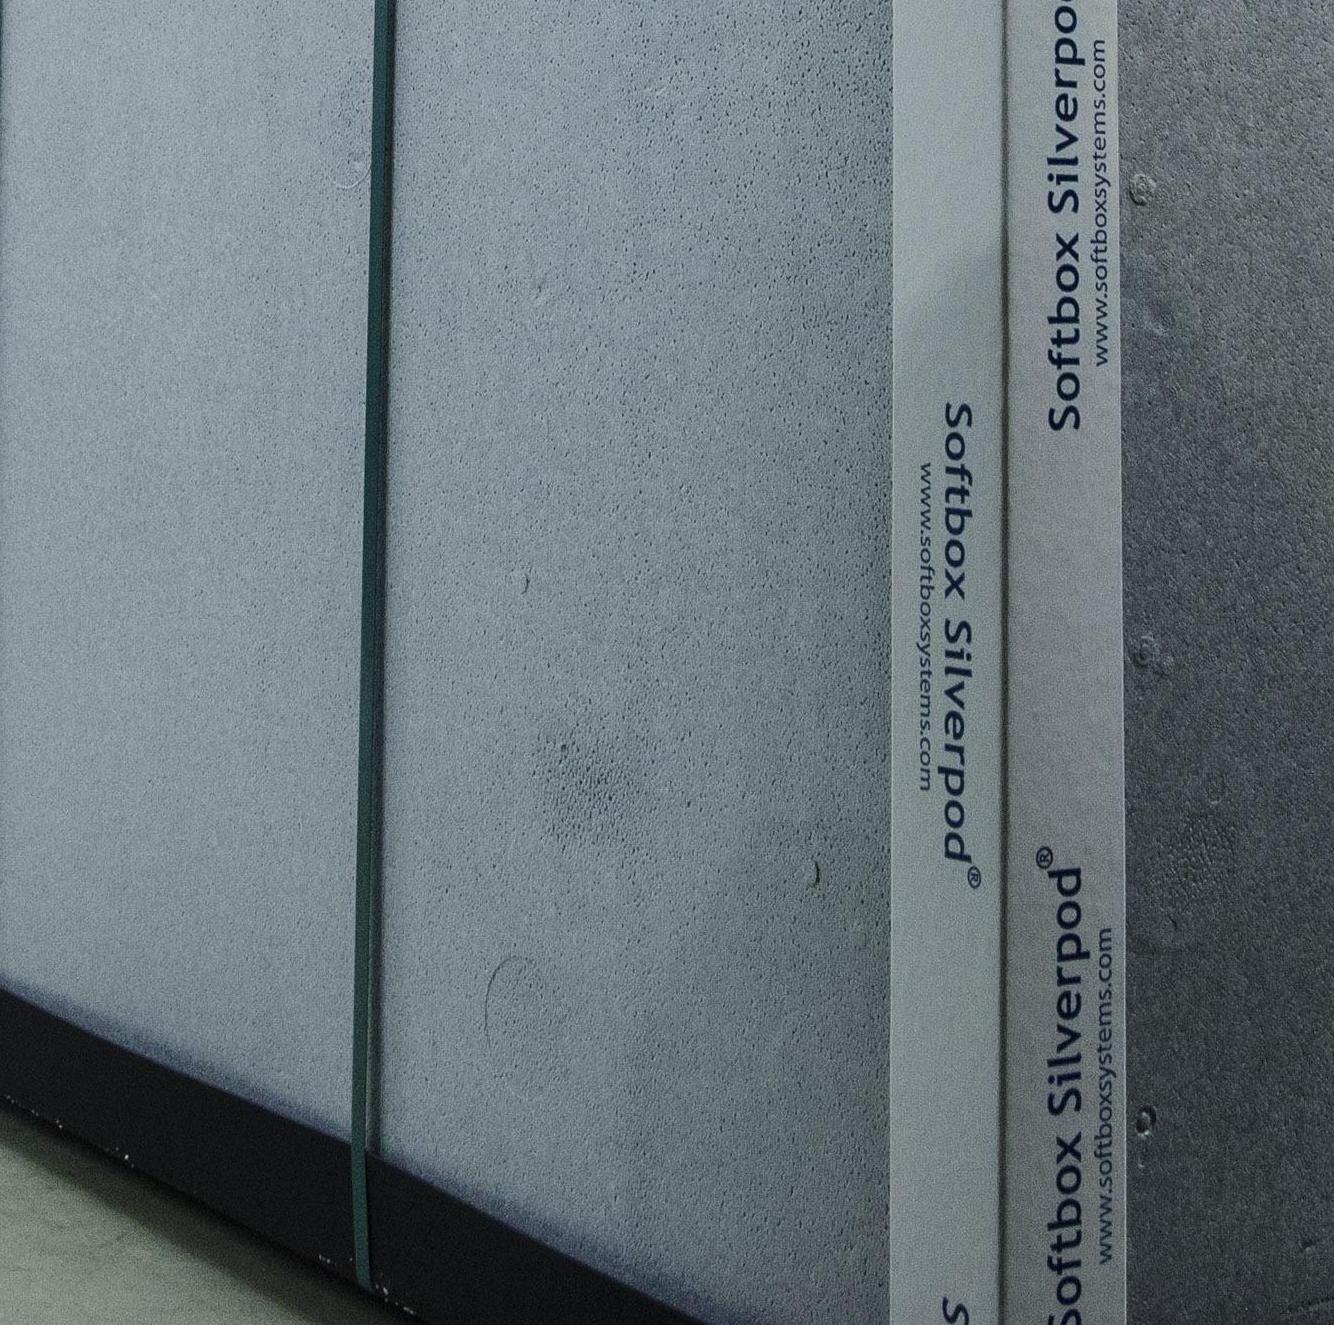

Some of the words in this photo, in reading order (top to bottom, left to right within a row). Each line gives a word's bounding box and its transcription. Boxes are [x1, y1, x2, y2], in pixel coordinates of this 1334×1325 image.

[1048, 232, 1081, 431] Softbox
[1091, 38, 1112, 367] www.softboxsystems.com
[916, 461, 936, 793] www.softboxsystems.com
[944, 401, 973, 601] Softbox
[1093, 927, 1117, 1265] www.softboxsystems.com
